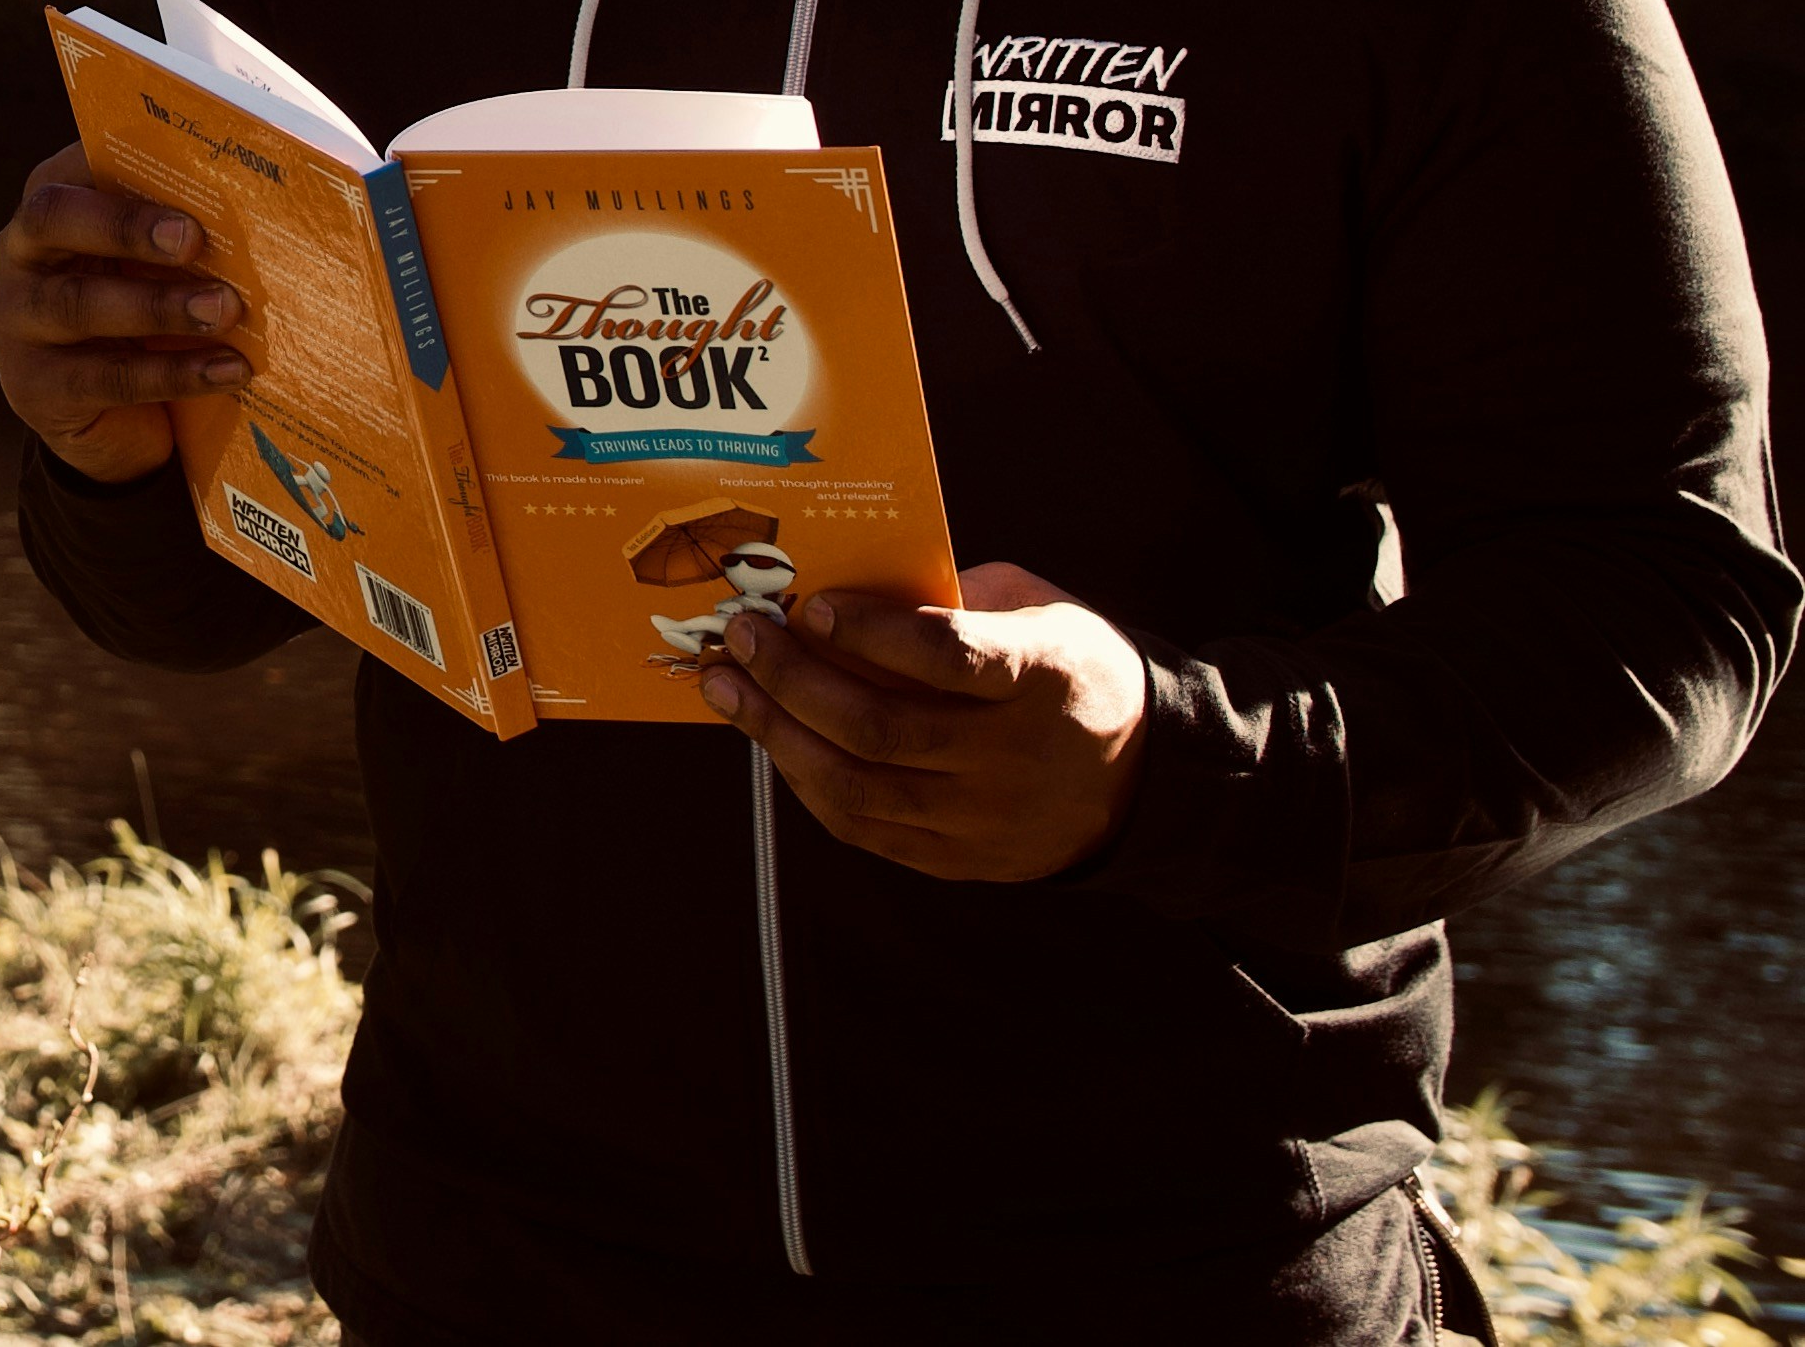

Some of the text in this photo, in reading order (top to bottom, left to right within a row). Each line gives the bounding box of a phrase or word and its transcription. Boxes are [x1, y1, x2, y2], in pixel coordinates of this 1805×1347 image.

[971, 34, 1188, 91] WRITTEN
[140, 92, 171, 125] The
[168, 111, 238, 162] Thought
[505, 190, 754, 210] JAY MULLINGS
[385, 205, 436, 350] JAY MULLINGS
[652, 288, 710, 315] The
[515, 278, 787, 380] Thought
[591, 438, 779, 457] STRIVING LEADS TO THRIVING
[486, 474, 508, 482] This
[510, 474, 538, 482] book
[542, 475, 550, 483] is
[553, 475, 586, 483] made
[589, 476, 601, 484] to
[817, 492, 840, 500] and
[232, 492, 300, 548] WRITTEN
[497, 626, 521, 670] WRITTEN
